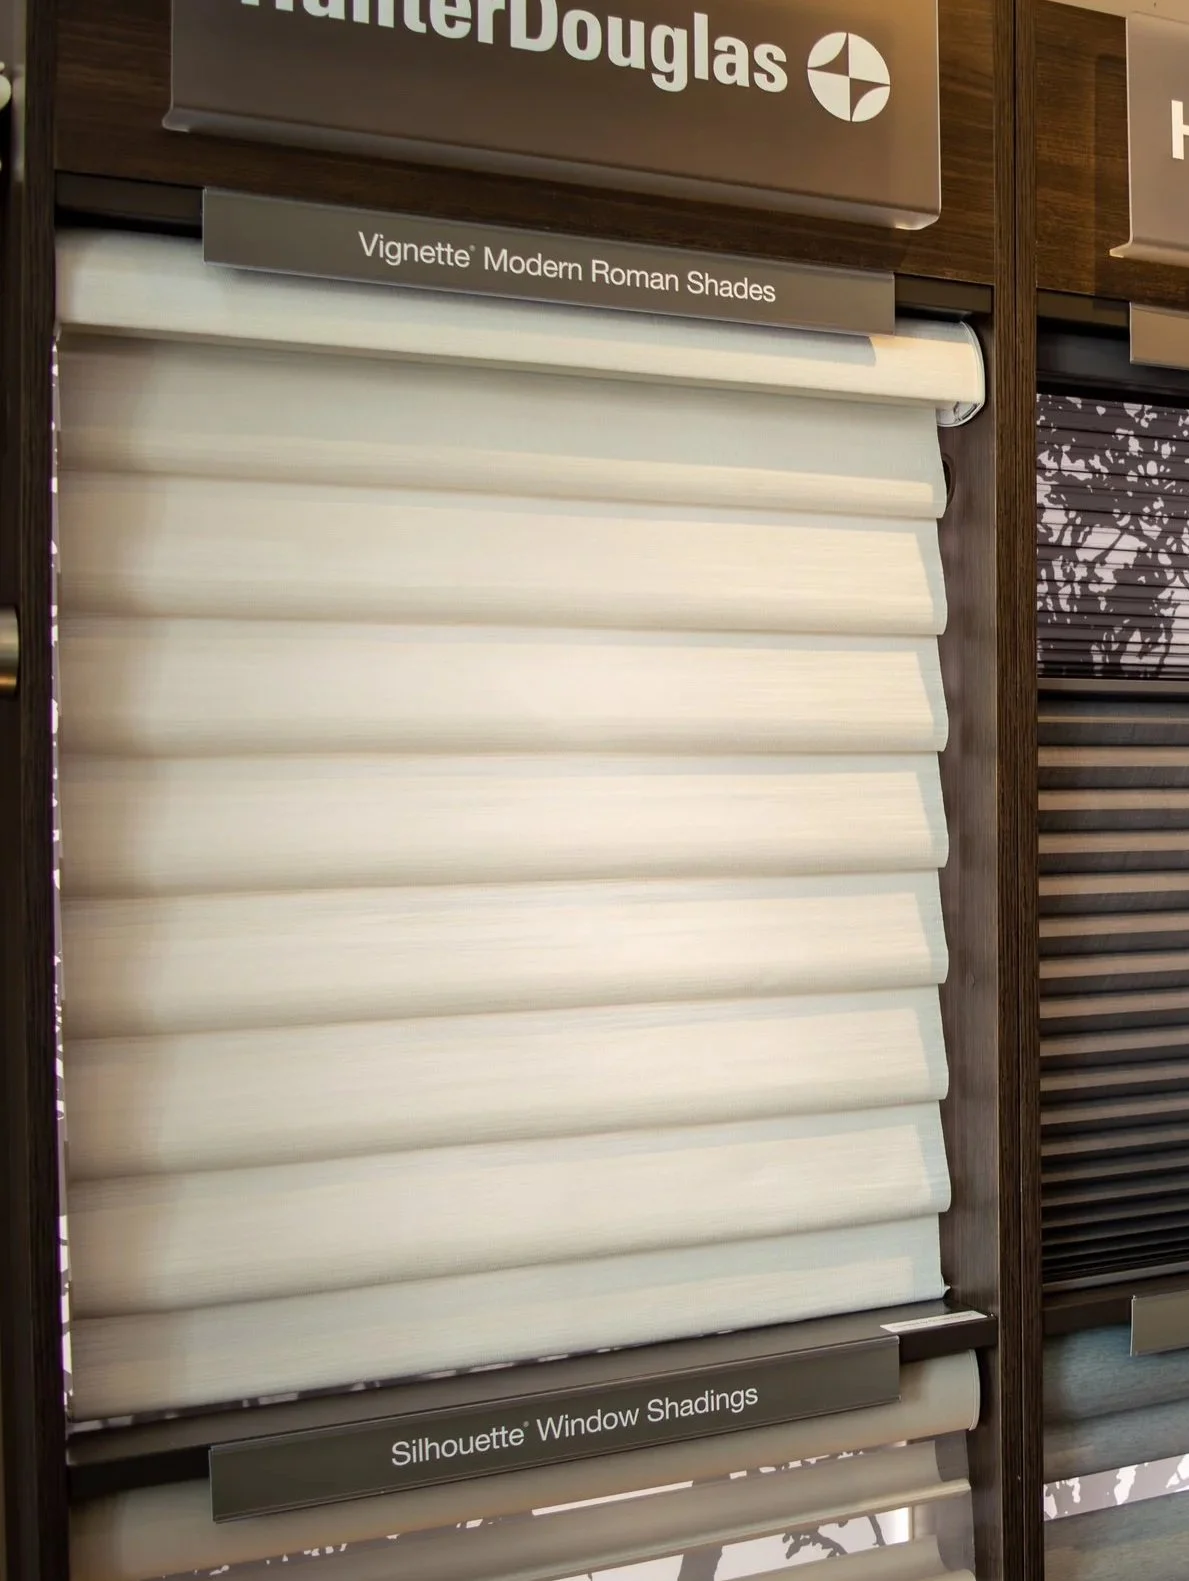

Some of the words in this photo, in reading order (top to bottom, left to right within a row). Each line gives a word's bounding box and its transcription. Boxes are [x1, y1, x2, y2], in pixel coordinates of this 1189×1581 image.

[485, 247, 582, 280] Modern
[592, 260, 678, 291] Roman
[687, 271, 775, 302] Shades
[537, 1408, 639, 1441] Window
[648, 1389, 758, 1421] Shadings
